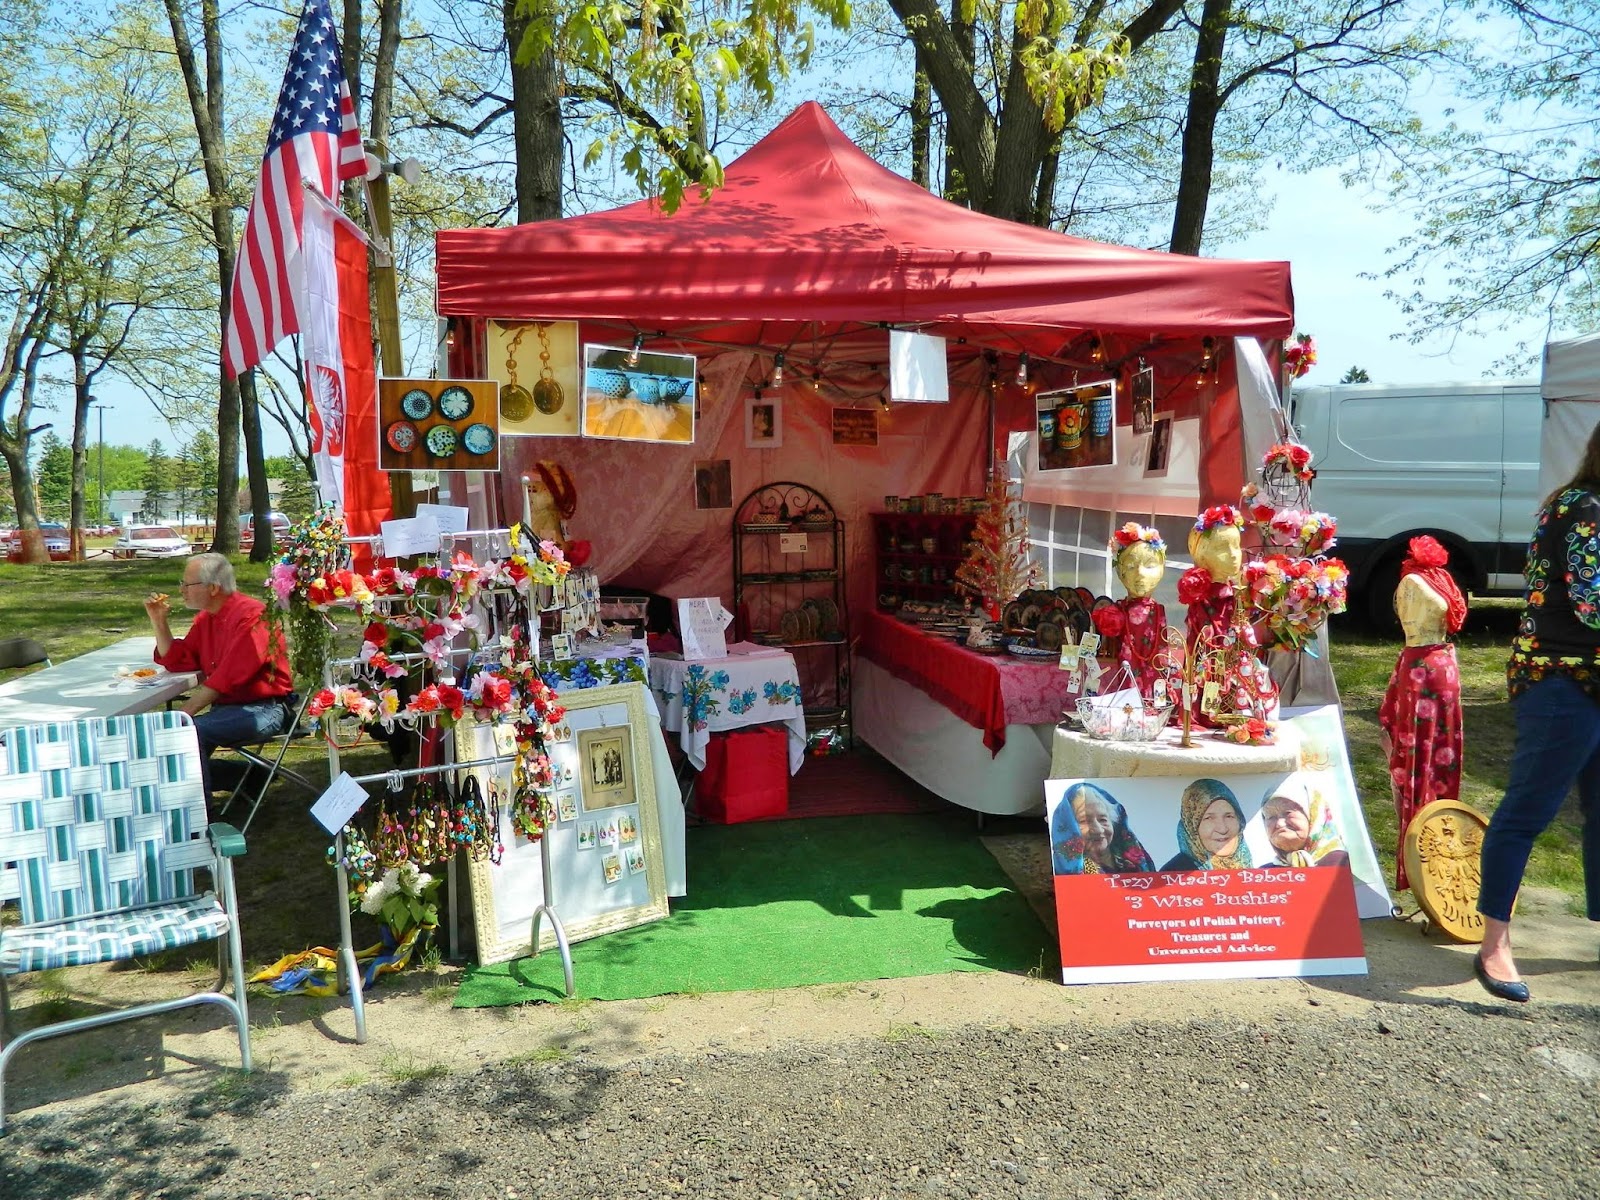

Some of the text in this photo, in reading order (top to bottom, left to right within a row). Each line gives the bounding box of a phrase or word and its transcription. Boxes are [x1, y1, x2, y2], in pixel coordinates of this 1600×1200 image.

[1104, 869, 1306, 889] Trzy Madry Babcie
[1124, 890, 1292, 909] "3 Wise Bushias"
[1128, 918, 1187, 930] Purveyors
[1189, 916, 1201, 927] of
[1203, 915, 1237, 926] Polish
[1171, 929, 1250, 942] Treasures and
[1148, 943, 1276, 956] Unwanted Advice
